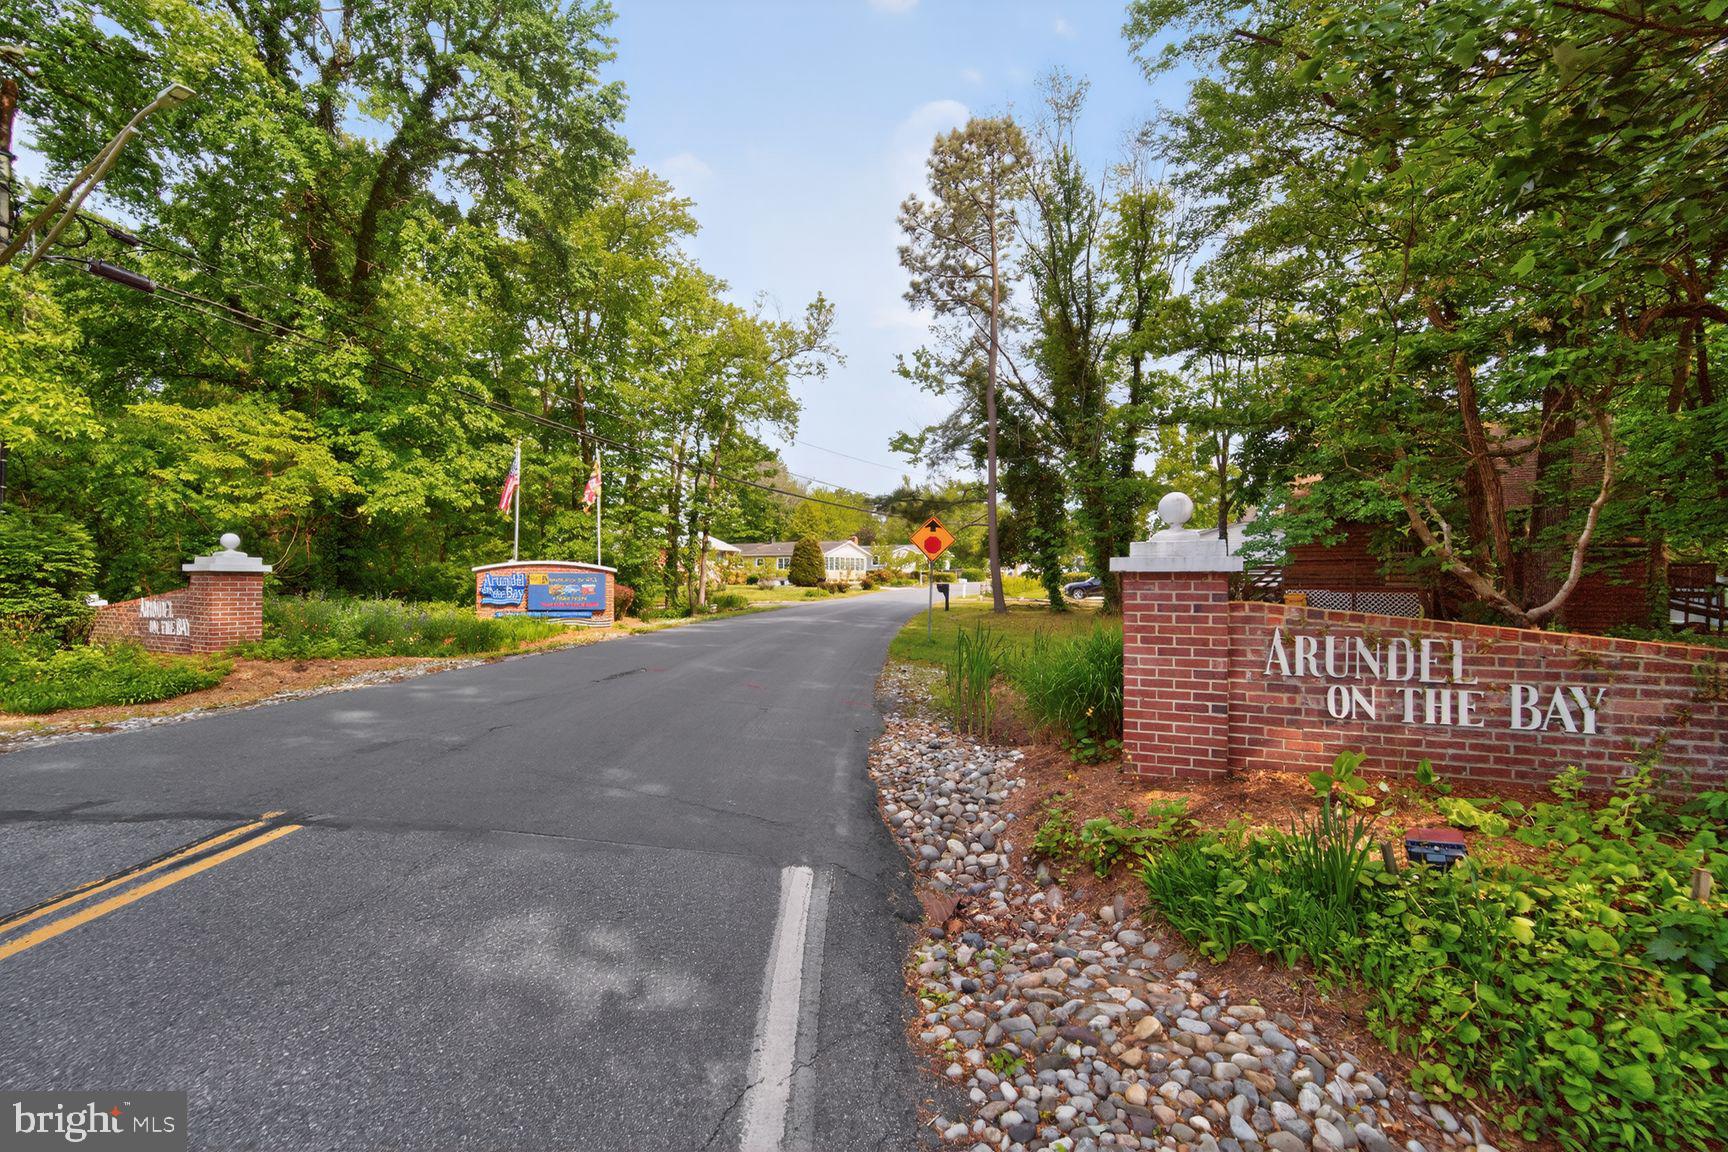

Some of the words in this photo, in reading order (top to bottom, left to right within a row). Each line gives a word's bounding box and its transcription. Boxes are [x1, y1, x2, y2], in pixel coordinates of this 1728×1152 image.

[484, 573, 525, 587] Arundel
[506, 585, 524, 602] Bay
[161, 620, 175, 635] THE
[176, 618, 190, 636] BAY
[1263, 626, 1478, 686] ARUNDEL
[1327, 684, 1376, 721] ON
[1396, 687, 1485, 728] THE
[1509, 683, 1606, 735] BAY
